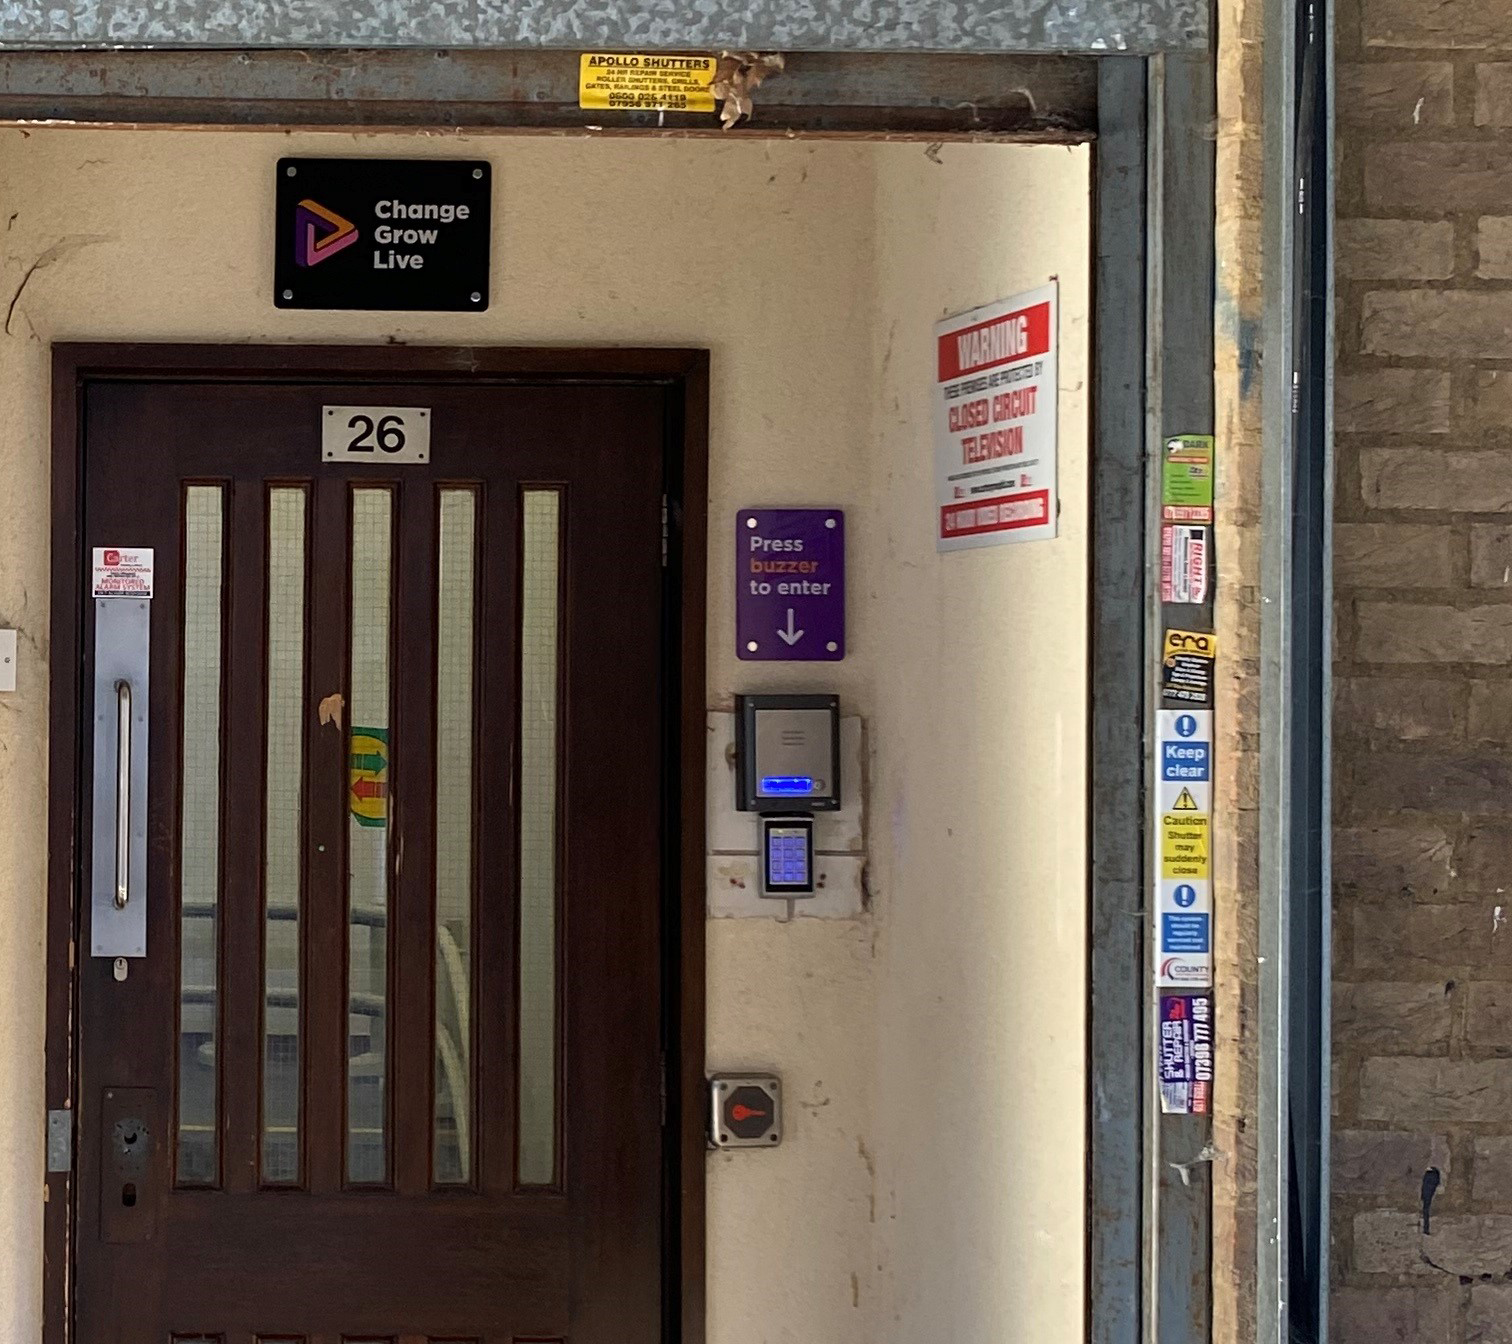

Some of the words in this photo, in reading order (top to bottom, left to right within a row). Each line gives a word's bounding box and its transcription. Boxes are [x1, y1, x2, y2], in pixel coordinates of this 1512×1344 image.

[589, 56, 639, 66] APOLLO
[644, 58, 710, 69] SHUTTERS
[374, 200, 470, 223] Change
[374, 225, 438, 244] Grow
[373, 250, 424, 269] Live
[957, 315, 1028, 371] WARNING
[949, 399, 988, 433] CLOSED
[993, 386, 1037, 423] CIRCUIT
[347, 414, 406, 453] 26
[961, 426, 1023, 465] TELEVISION
[750, 536, 804, 552] Press
[750, 557, 819, 573] buzzer
[1193, 543, 1203, 583] RIGHT
[750, 579, 771, 595] to
[777, 579, 831, 595] enter
[1169, 633, 1208, 650] era
[1166, 745, 1205, 761] Keep
[1166, 764, 1205, 777] clear
[1163, 816, 1207, 825] Caution
[1168, 831, 1202, 839] Shutter
[1163, 855, 1207, 864] suddenly
[1193, 1023, 1210, 1042] 777
[1163, 1021, 1174, 1078] SHUTTER
[1173, 1021, 1183, 1063] REPAIR
[1173, 1069, 1184, 1078] &
